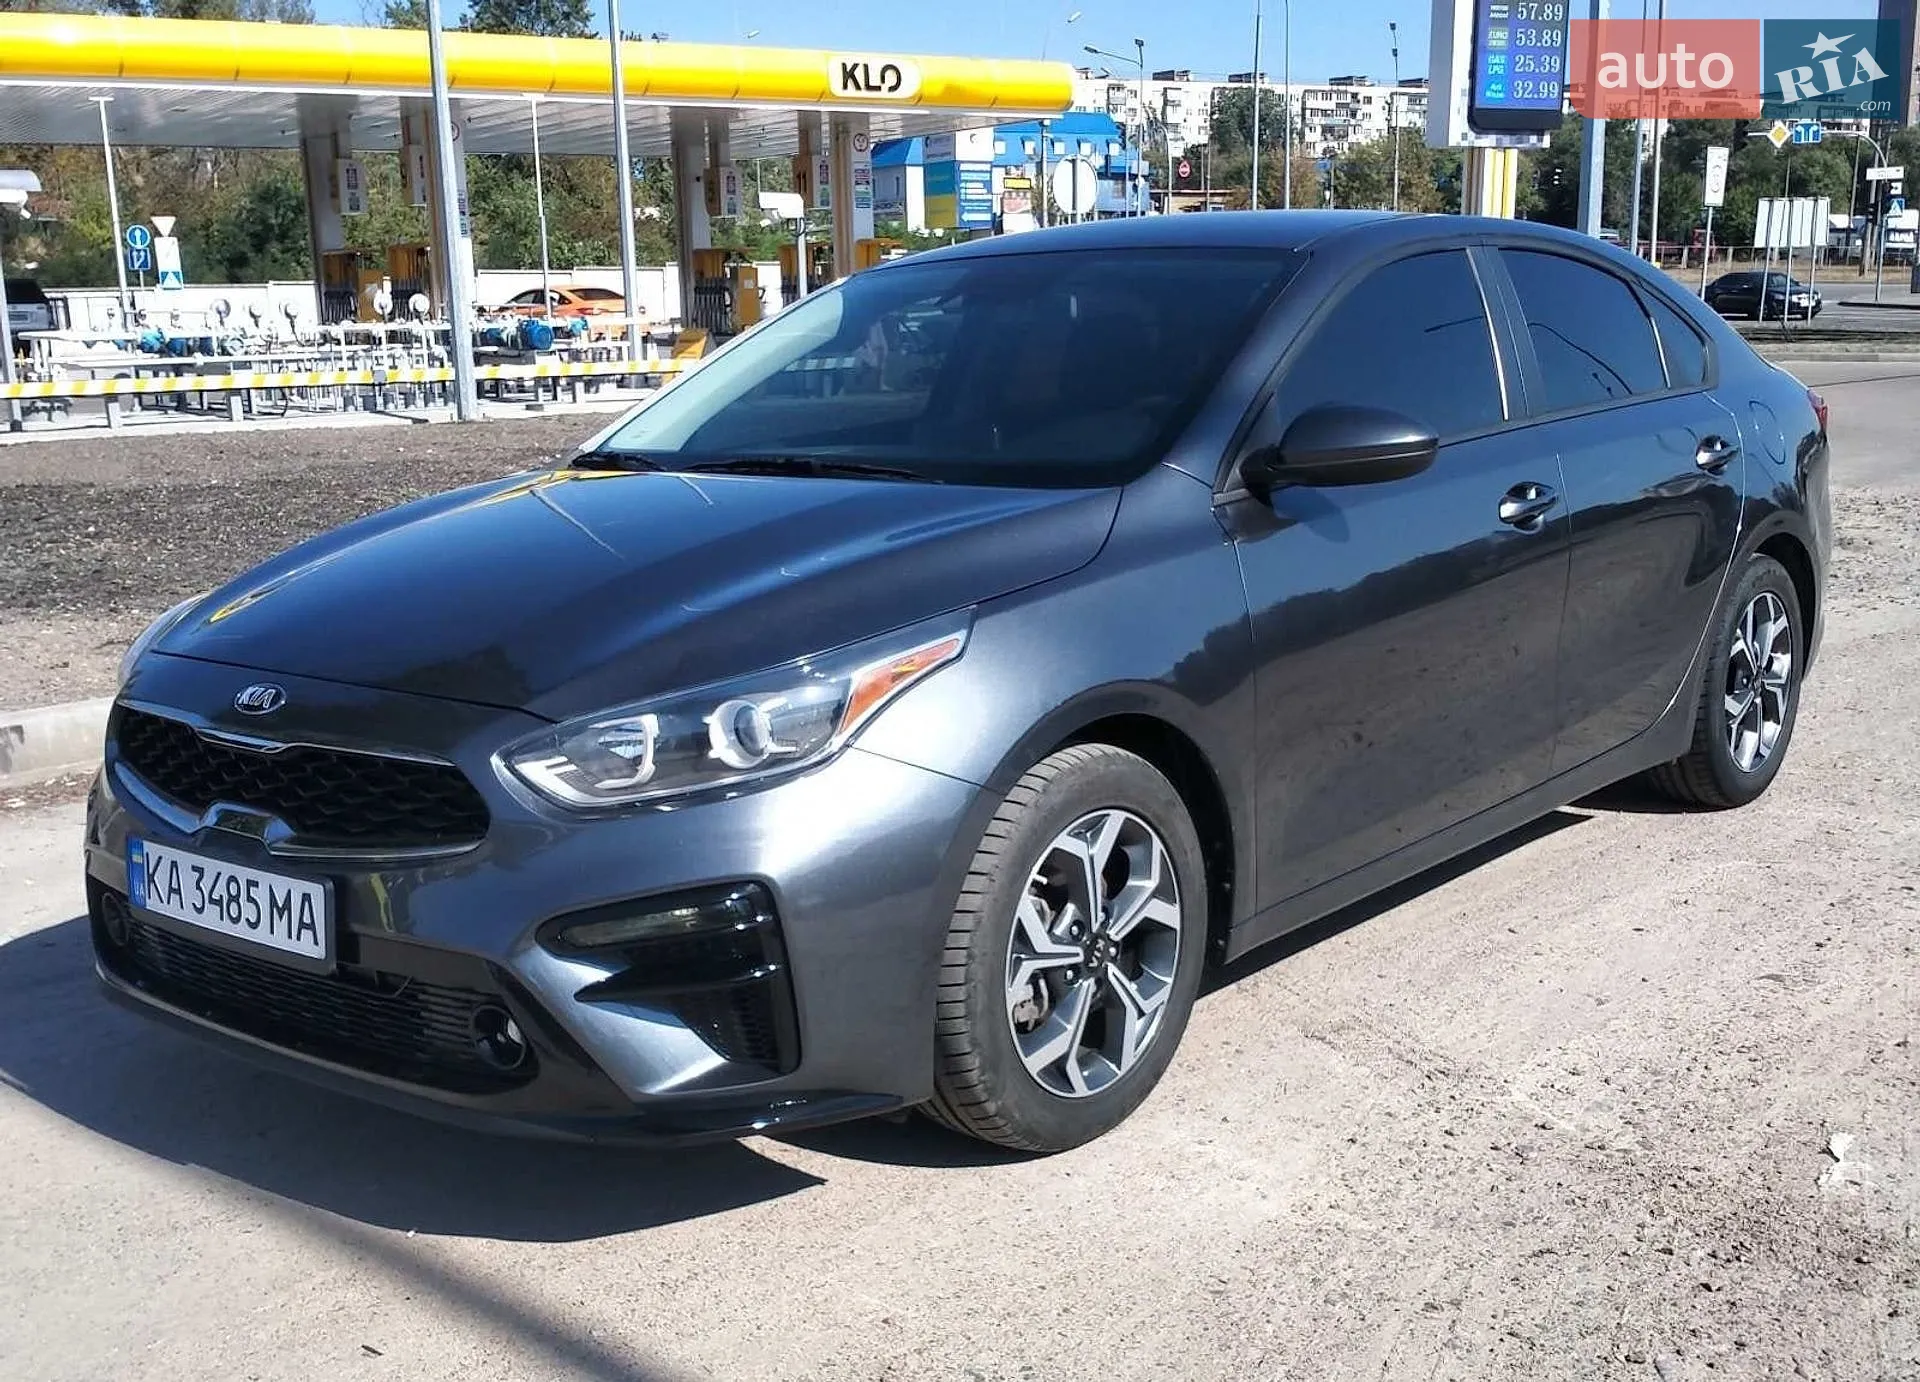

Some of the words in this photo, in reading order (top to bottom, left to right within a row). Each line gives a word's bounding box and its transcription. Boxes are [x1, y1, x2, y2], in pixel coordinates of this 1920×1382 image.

[1517, 2, 1562, 20] 57.89
[1516, 28, 1561, 47] 53.89
[1515, 54, 1560, 73] 25.39
[841, 62, 902, 93] KLO
[1513, 80, 1558, 99] 32.99
[238, 686, 275, 708] KIA
[145, 852, 184, 910] KA
[191, 864, 262, 930] 3485
[269, 884, 319, 946] MA
